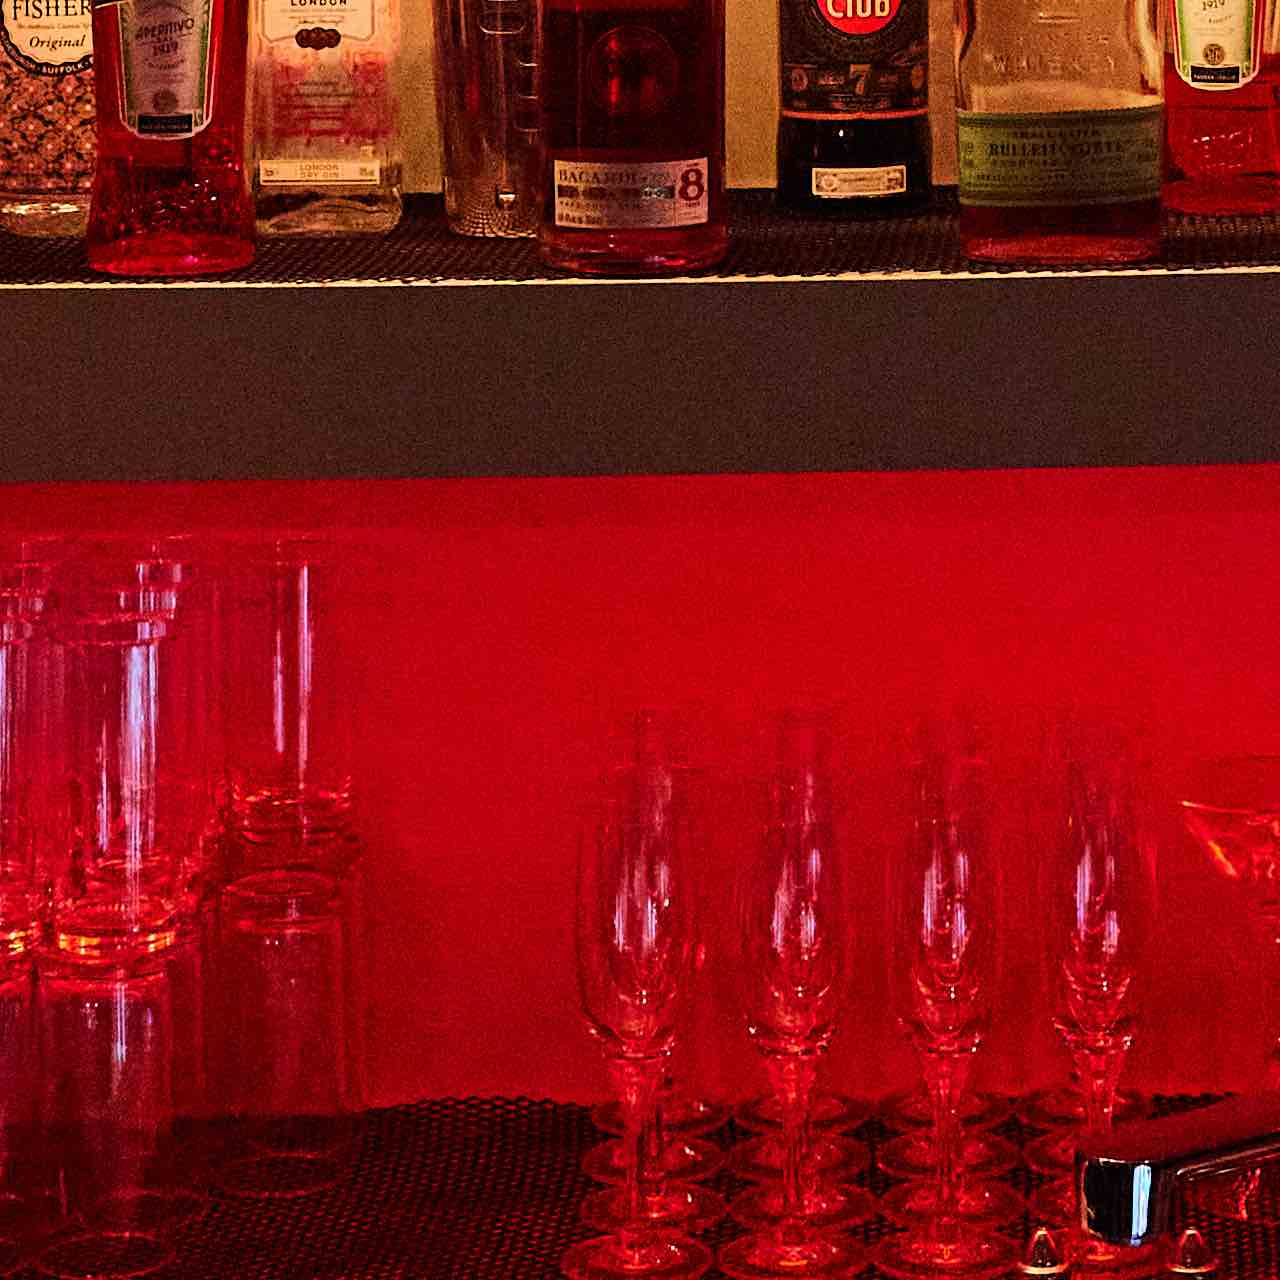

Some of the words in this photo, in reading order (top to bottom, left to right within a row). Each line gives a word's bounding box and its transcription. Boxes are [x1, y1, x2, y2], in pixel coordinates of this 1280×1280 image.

[135, 17, 195, 41] APERITIVO
[29, 33, 87, 52] Original
[152, 41, 179, 56] 1919
[849, 63, 871, 96] 7
[678, 167, 705, 202] 8
